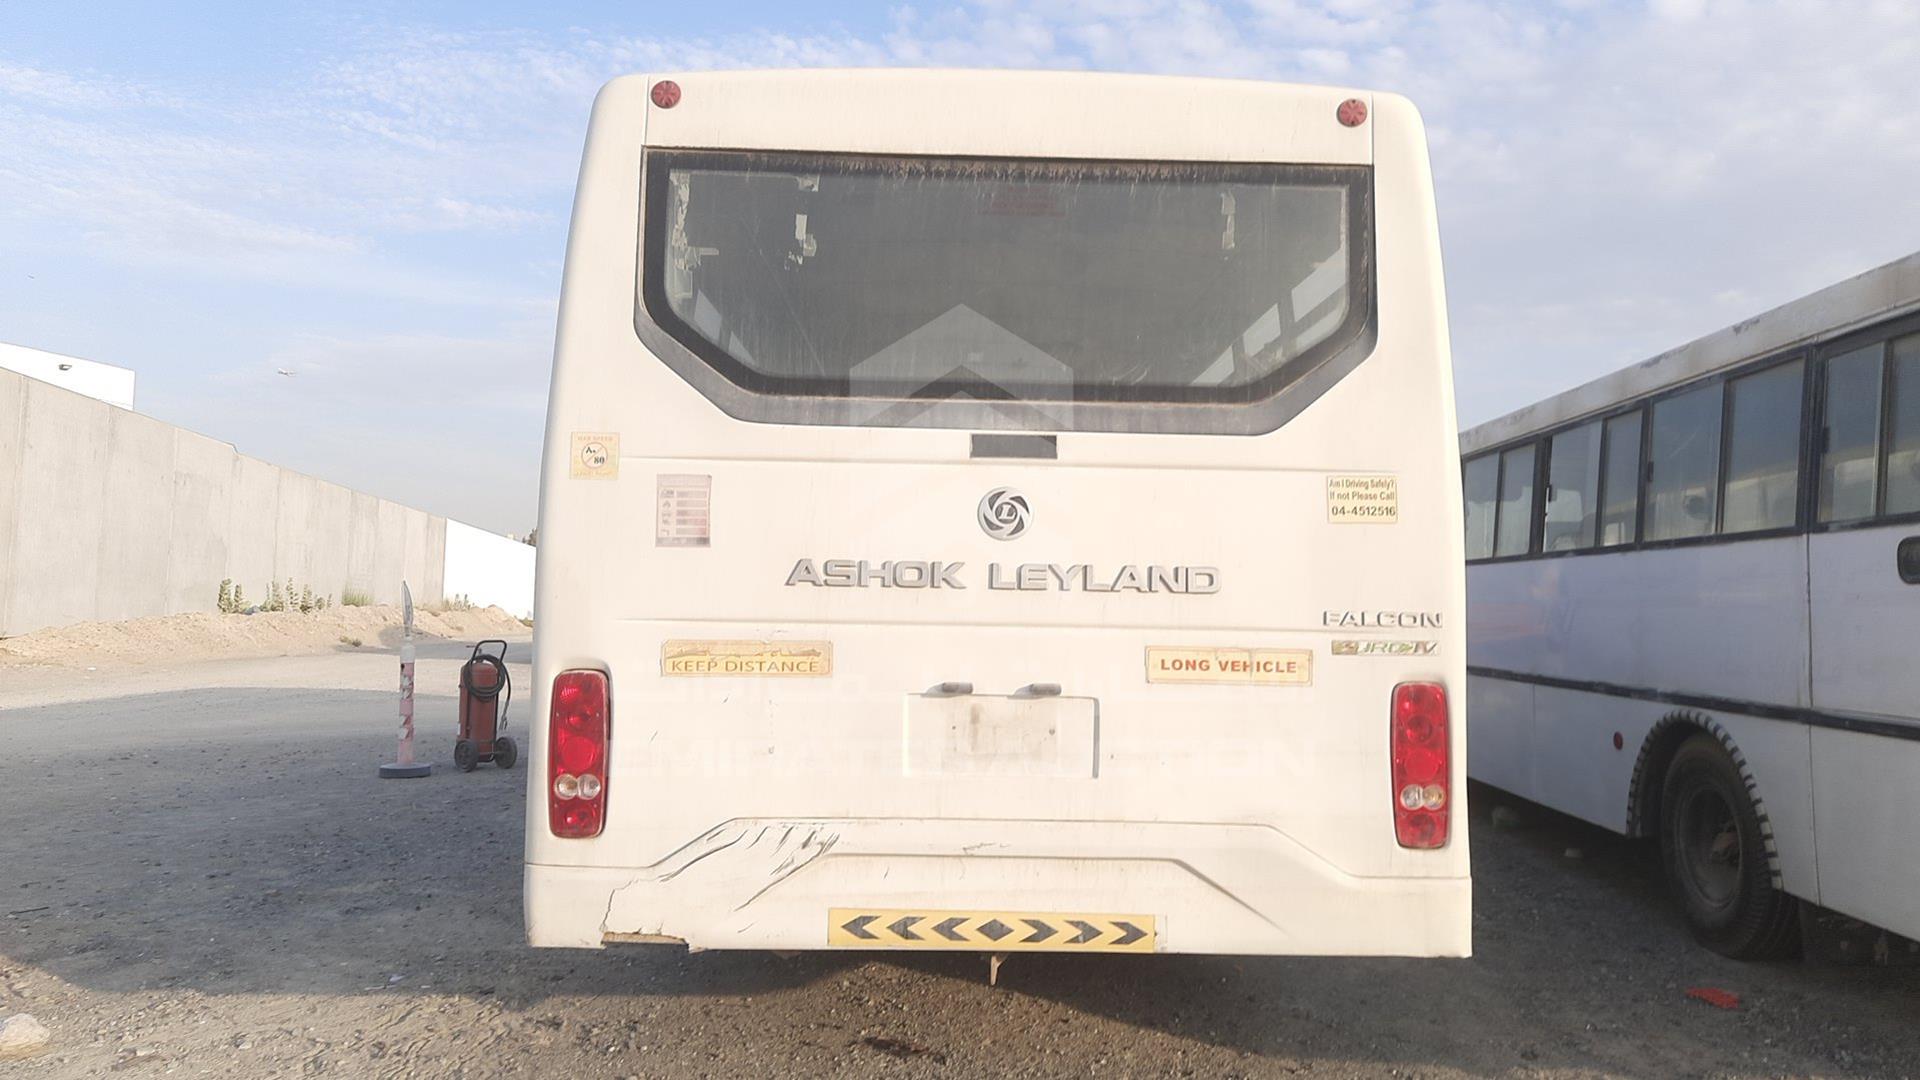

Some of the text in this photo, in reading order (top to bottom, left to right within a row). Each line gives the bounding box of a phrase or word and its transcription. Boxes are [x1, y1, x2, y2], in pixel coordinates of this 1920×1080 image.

[593, 456, 605, 464] 80
[1346, 479, 1369, 490] Driving
[1370, 479, 1394, 490] Safely?
[1330, 491, 1395, 501] If not Please Call
[1331, 506, 1396, 516] 04-4512516
[784, 558, 1222, 595] ASHOK LEYLAND
[1322, 611, 1442, 629] FALCON
[671, 660, 820, 672] KEEP DISTANCE
[1160, 658, 1297, 673] LONG VEHICLE
